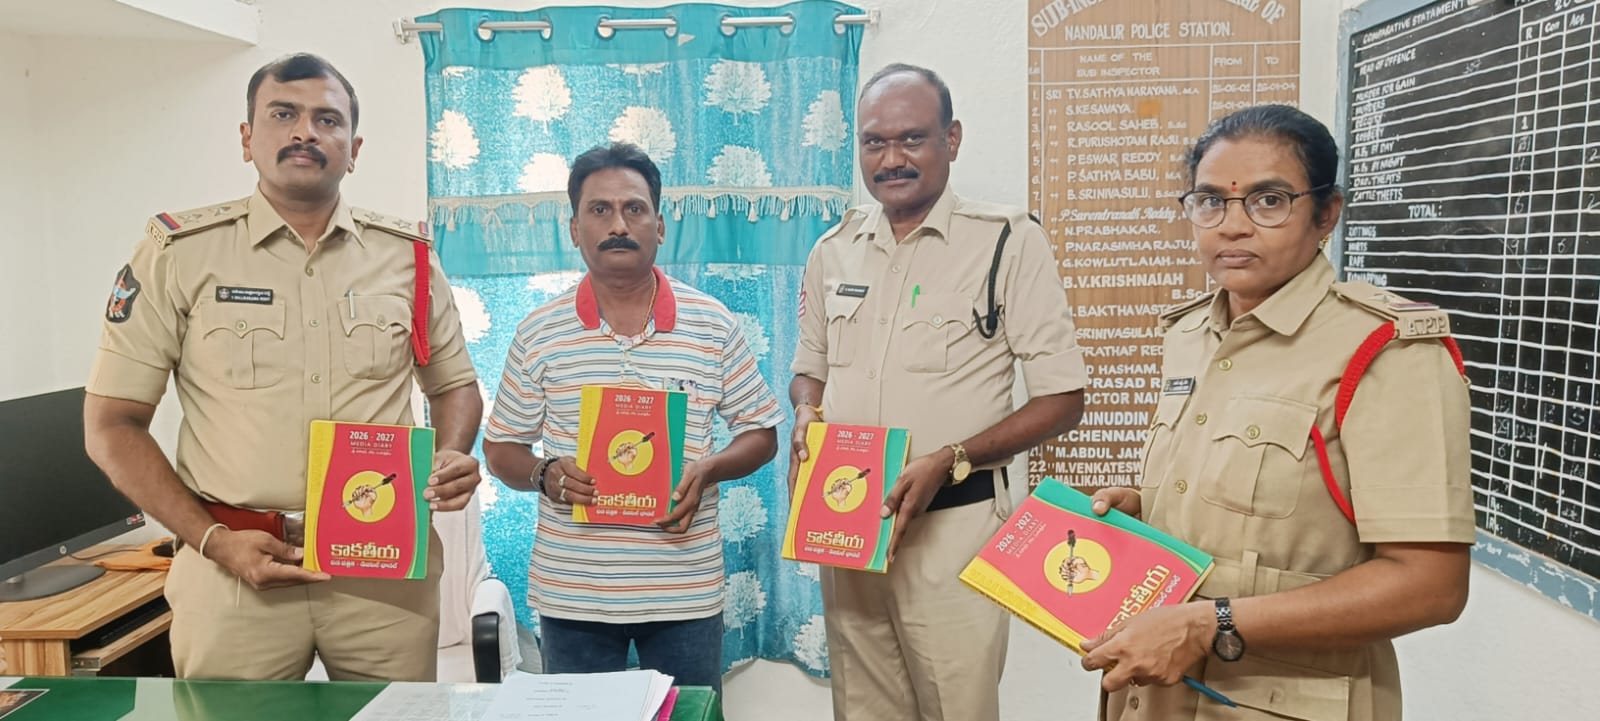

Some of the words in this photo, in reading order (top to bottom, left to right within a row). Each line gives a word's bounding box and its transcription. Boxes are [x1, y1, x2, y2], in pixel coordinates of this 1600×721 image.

[1064, 24, 1124, 41] NANDALUR
[1131, 23, 1170, 39] POLICE
[1179, 21, 1235, 37] STATION.
[1526, 27, 1532, 40] R
[1079, 55, 1106, 63] NAME
[1110, 53, 1123, 62] OF
[1132, 53, 1152, 61] THE
[1214, 57, 1242, 66] FROM
[1264, 56, 1279, 65] TO
[1101, 66, 1160, 76] INSPECTOR
[1046, 90, 1061, 100] SRI
[1067, 121, 1117, 132] RASOOL
[1063, 272, 1184, 289] B.V.KRISHNAIAH
[614, 394, 632, 403] 2026
[637, 396, 654, 405] 2027
[1079, 411, 1149, 426] AINUDDIN
[349, 430, 369, 440] 2026
[375, 432, 395, 442] 2027
[837, 430, 853, 439] 2026
[858, 431, 874, 441] 2027
[1055, 447, 1114, 459] M.ABDUL
[1029, 461, 1047, 473] 22
[1029, 474, 1040, 486] 23
[597, 492, 656, 508] కాకతీయ
[995, 533, 1014, 552] 2026
[1015, 512, 1033, 530] 2027
[806, 530, 864, 549] కాకతీయ
[330, 541, 400, 560] కాకతీయ
